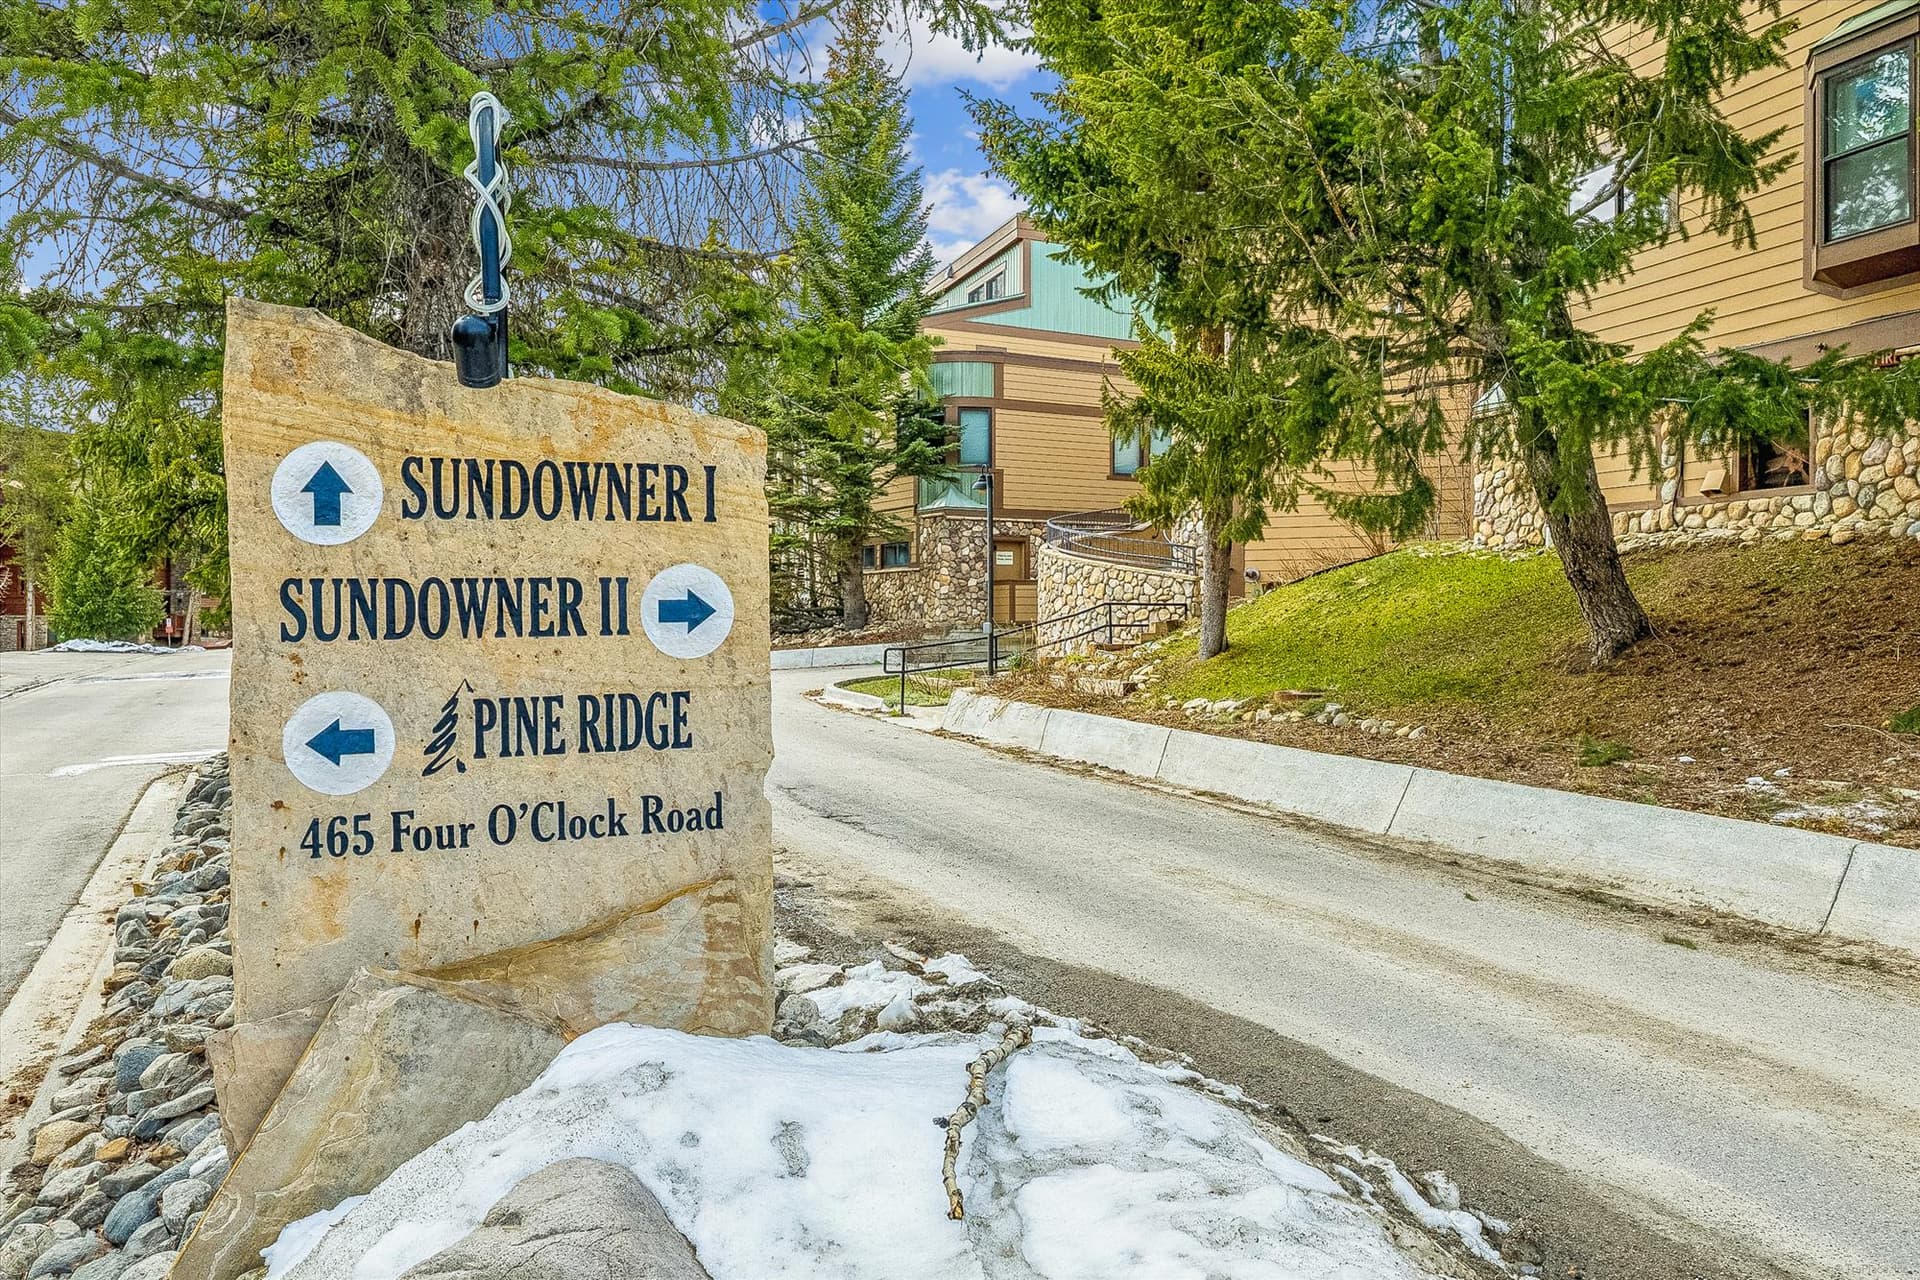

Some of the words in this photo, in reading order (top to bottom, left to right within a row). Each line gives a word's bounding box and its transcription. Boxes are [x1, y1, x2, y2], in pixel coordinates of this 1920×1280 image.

[402, 456, 692, 522] SUNDOWNER
[703, 465, 717, 523] I
[279, 576, 588, 643] SUNDOWNER
[598, 576, 630, 636] II
[473, 693, 566, 760] PINE
[578, 690, 693, 754] RIDGE
[300, 812, 375, 859] 465
[390, 809, 476, 853] Four
[488, 797, 630, 846] O'Clock
[640, 790, 724, 835] Road
